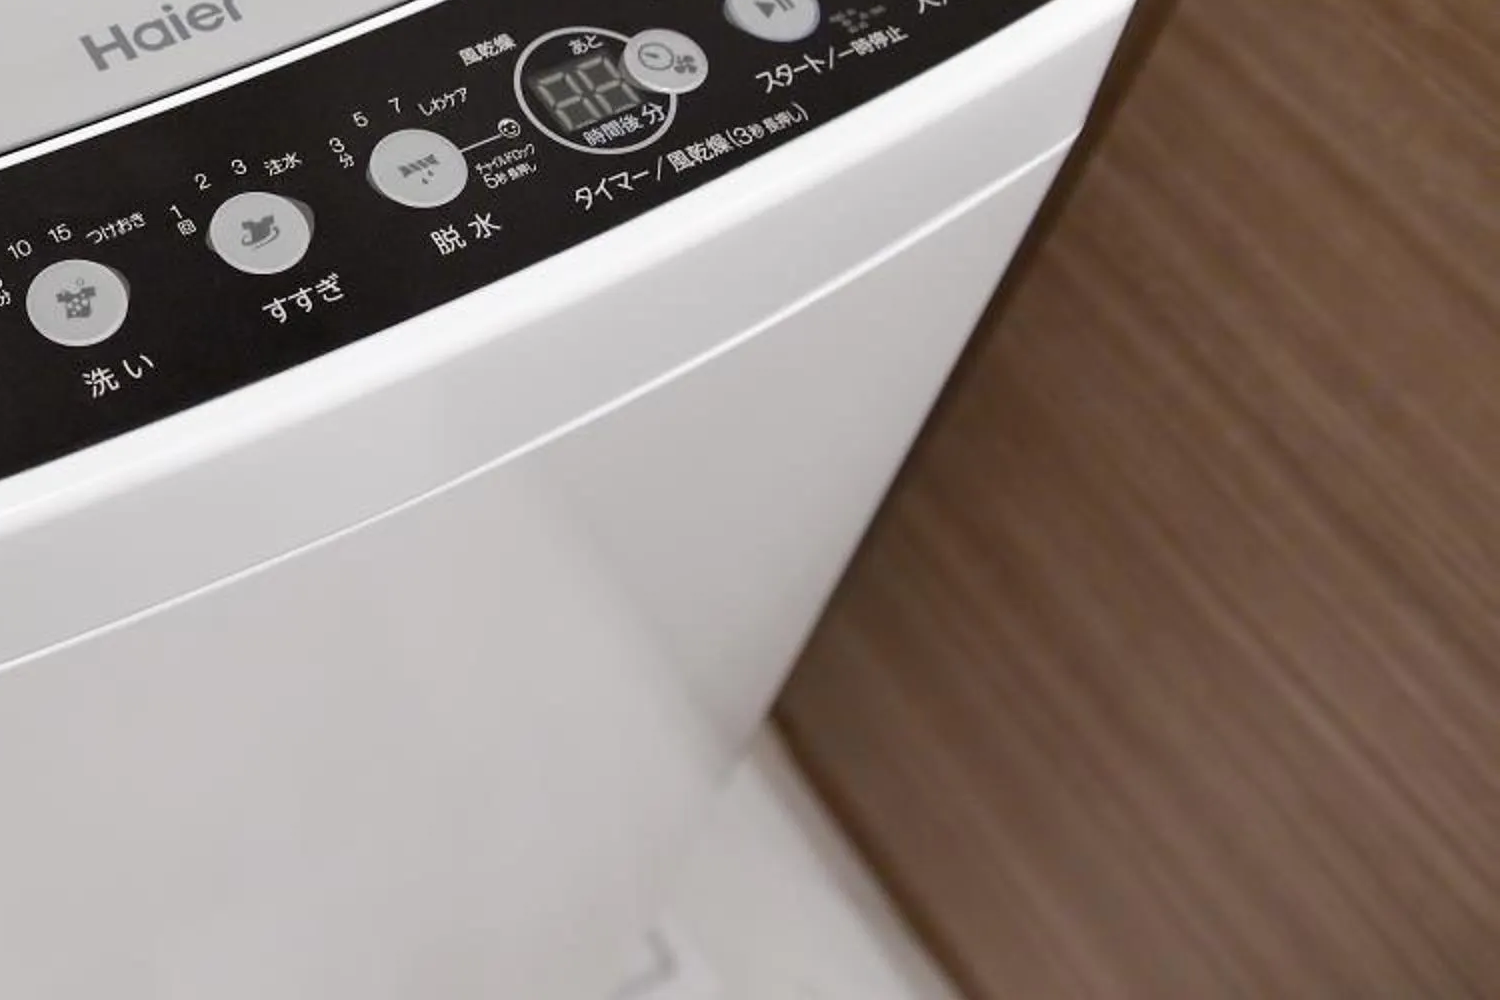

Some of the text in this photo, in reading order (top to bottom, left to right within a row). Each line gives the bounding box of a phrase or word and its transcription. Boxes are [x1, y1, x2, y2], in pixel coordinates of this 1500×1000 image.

[459, 33, 517, 67] 風乾燥
[568, 34, 603, 56] あと
[329, 87, 467, 153] 3 5 7 しわケア
[338, 152, 355, 169] 分
[169, 151, 302, 219] 1 2 3 注水
[7, 239, 33, 259] 10
[47, 223, 72, 243] 15
[86, 213, 146, 244] つけおき
[262, 271, 344, 324] すすぎ
